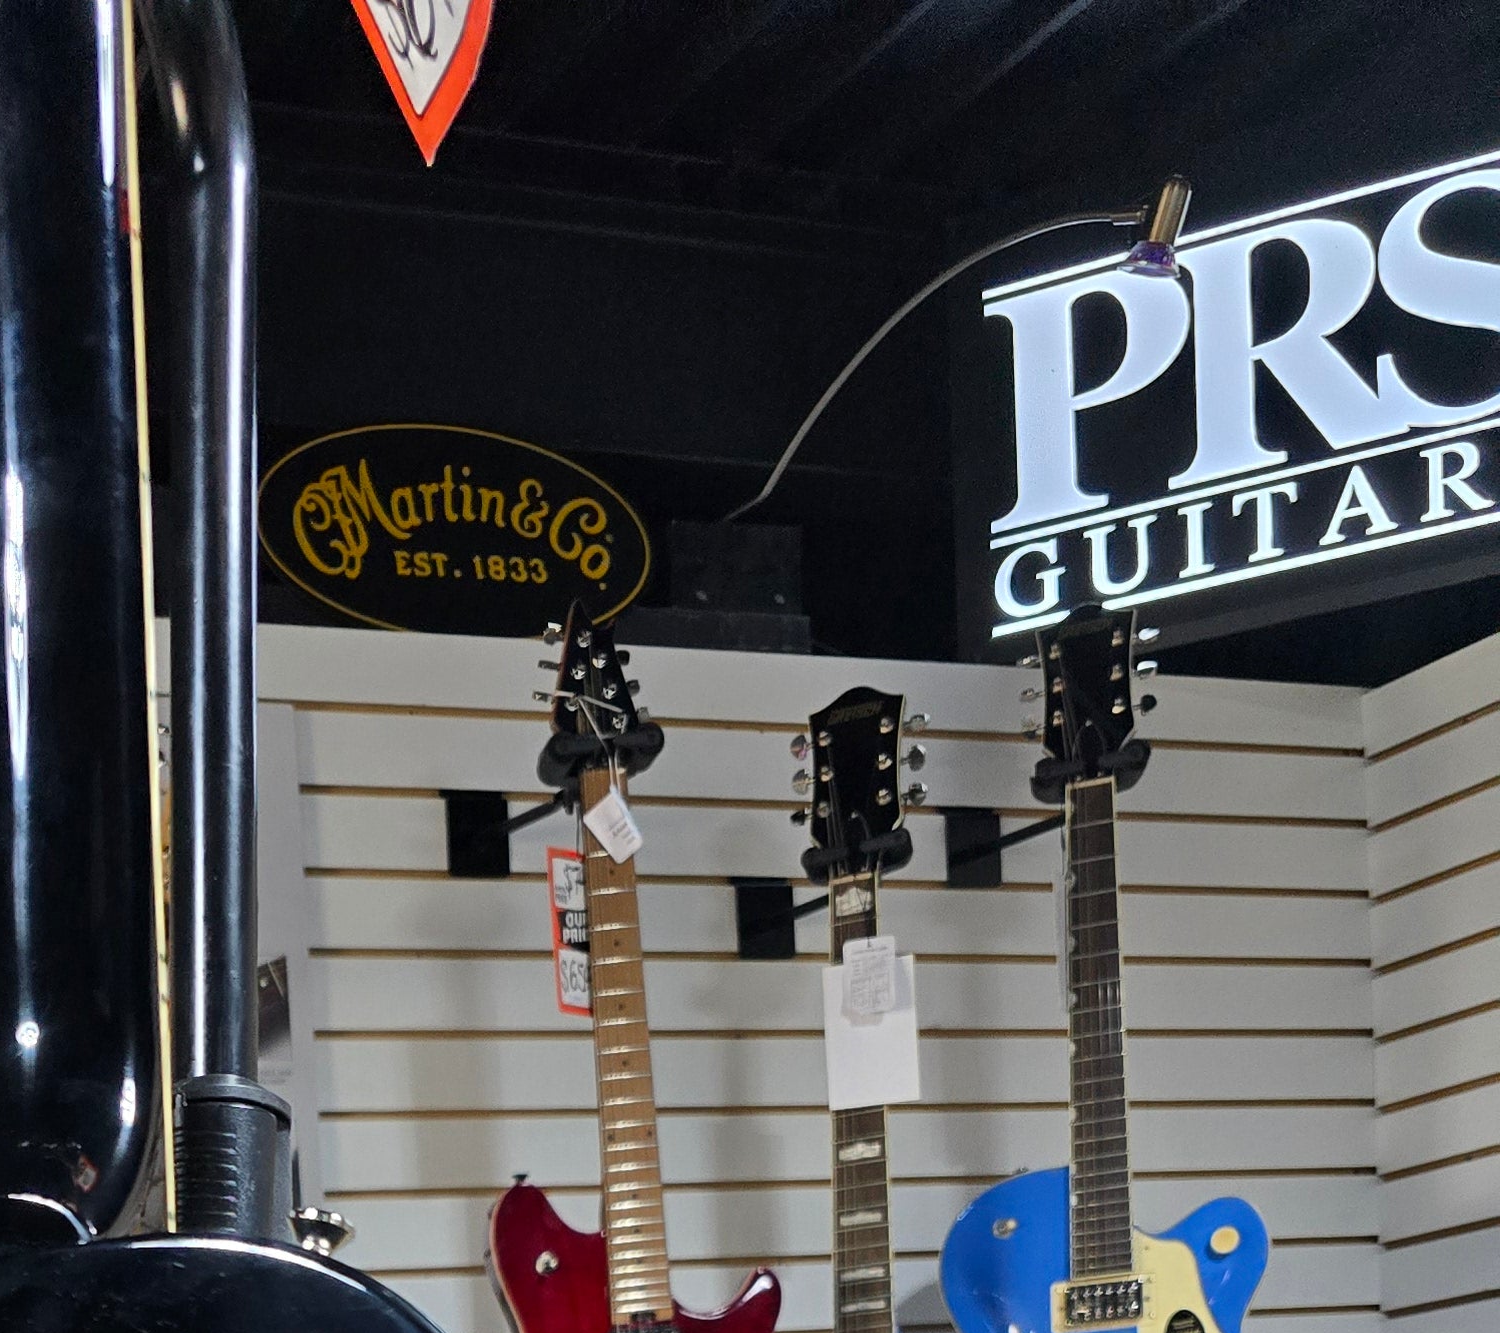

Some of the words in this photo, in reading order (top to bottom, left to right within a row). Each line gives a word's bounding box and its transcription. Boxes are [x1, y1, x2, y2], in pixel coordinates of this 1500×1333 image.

[983, 168, 1500, 534] PRS
[393, 550, 462, 579] EST.
[473, 554, 548, 584] 1833
